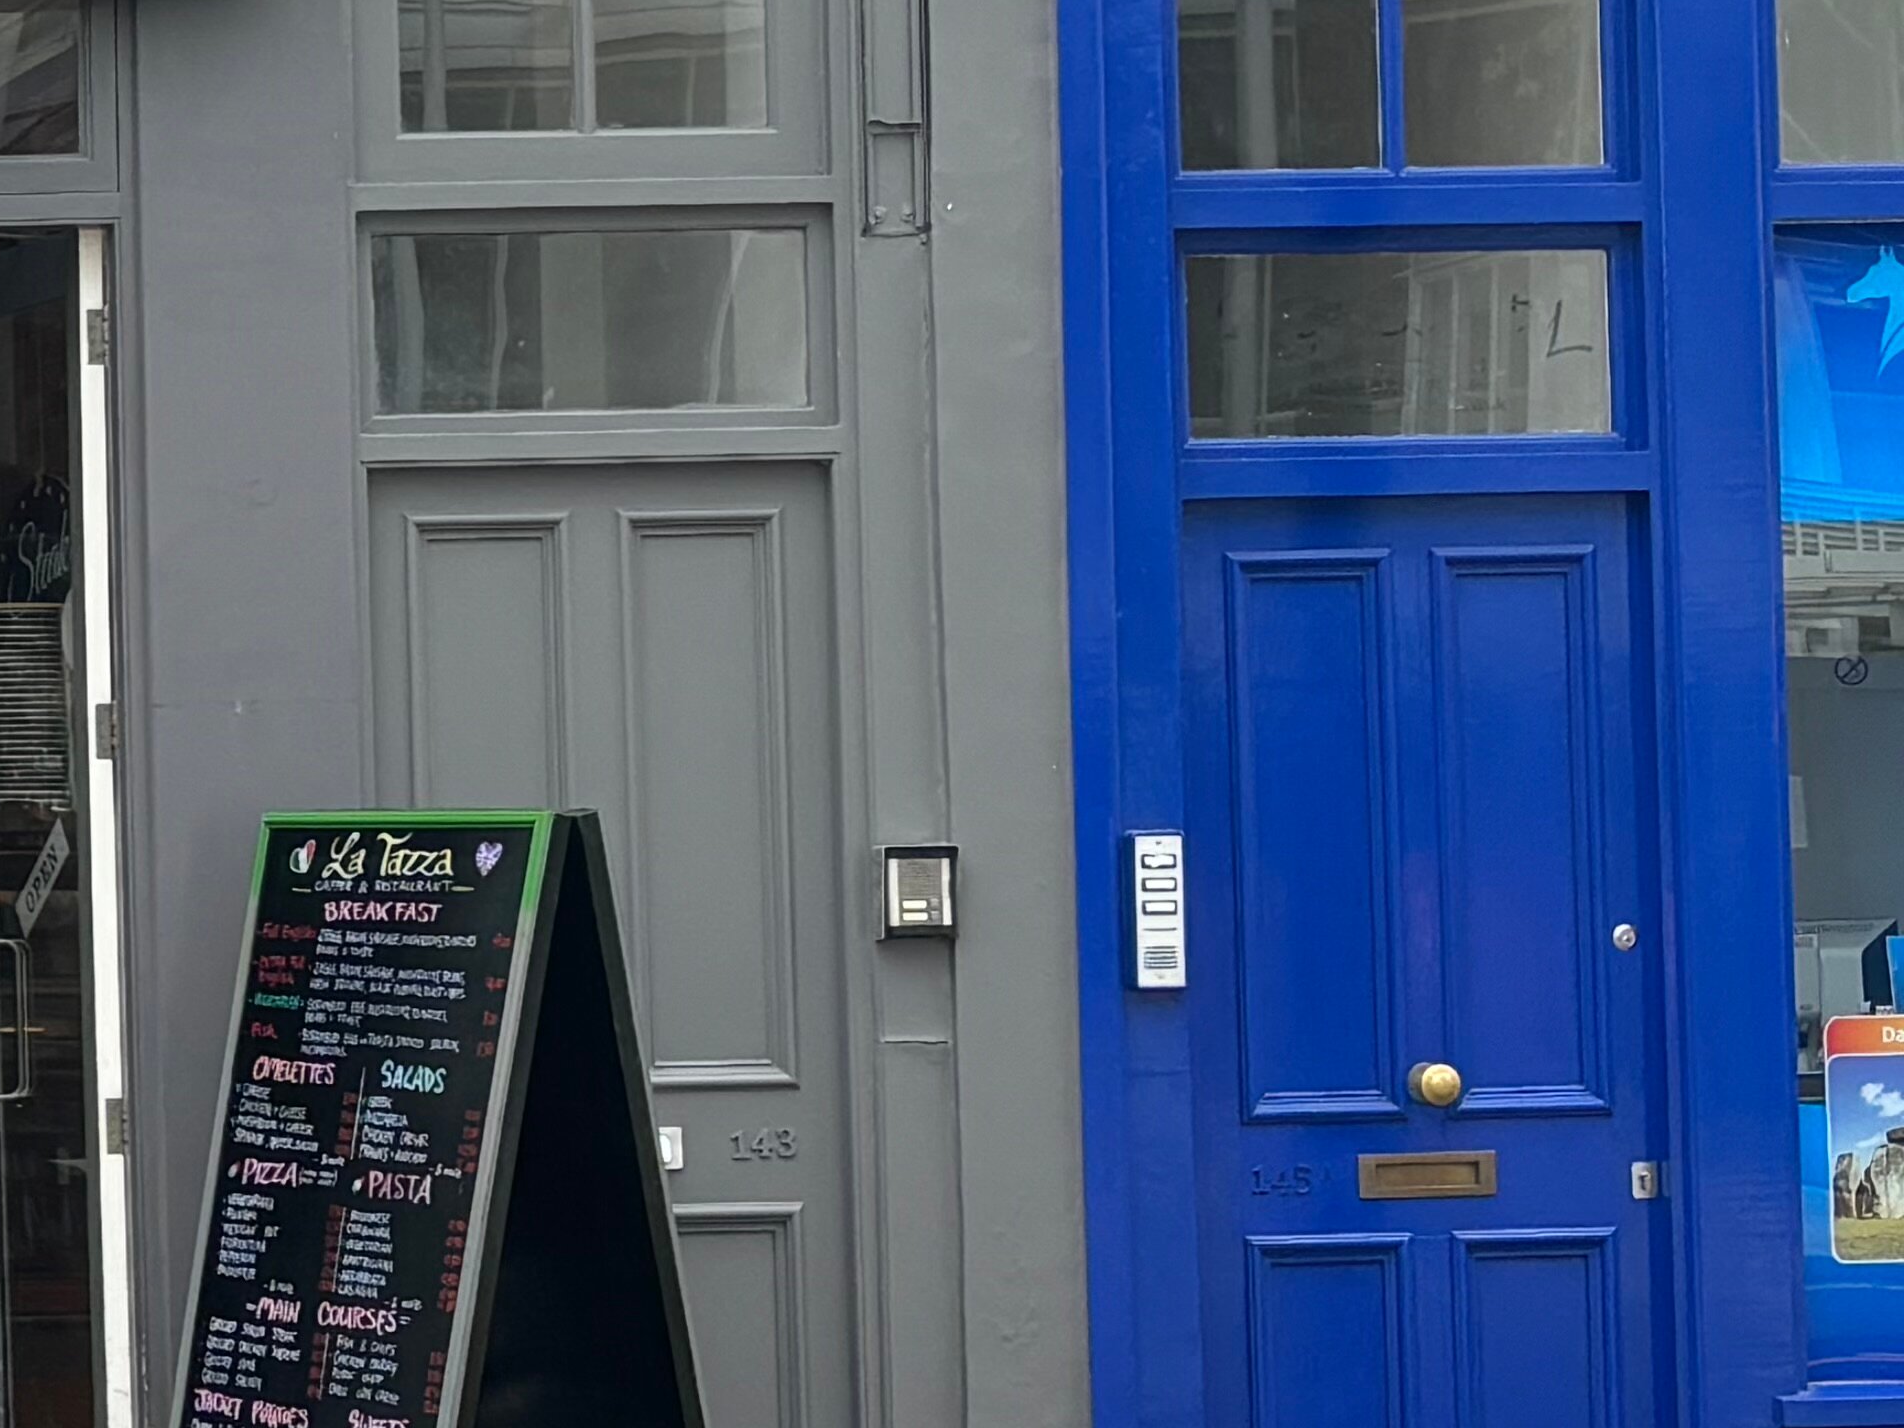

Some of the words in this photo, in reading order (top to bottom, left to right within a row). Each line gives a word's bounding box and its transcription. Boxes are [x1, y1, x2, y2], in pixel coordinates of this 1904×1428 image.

[321, 832, 366, 879] La
[376, 832, 454, 877] Tazza
[26, 843, 58, 913] OPEN
[324, 901, 443, 922] BREAKFAST
[253, 1056, 336, 1084] OMELETTES
[380, 1059, 447, 1093] SALADS
[730, 1128, 797, 1161] 143
[241, 1158, 297, 1188] PIZZA
[368, 1170, 432, 1205] PASTA
[256, 1297, 301, 1323] MAIN
[317, 1301, 397, 1335] COURSES
